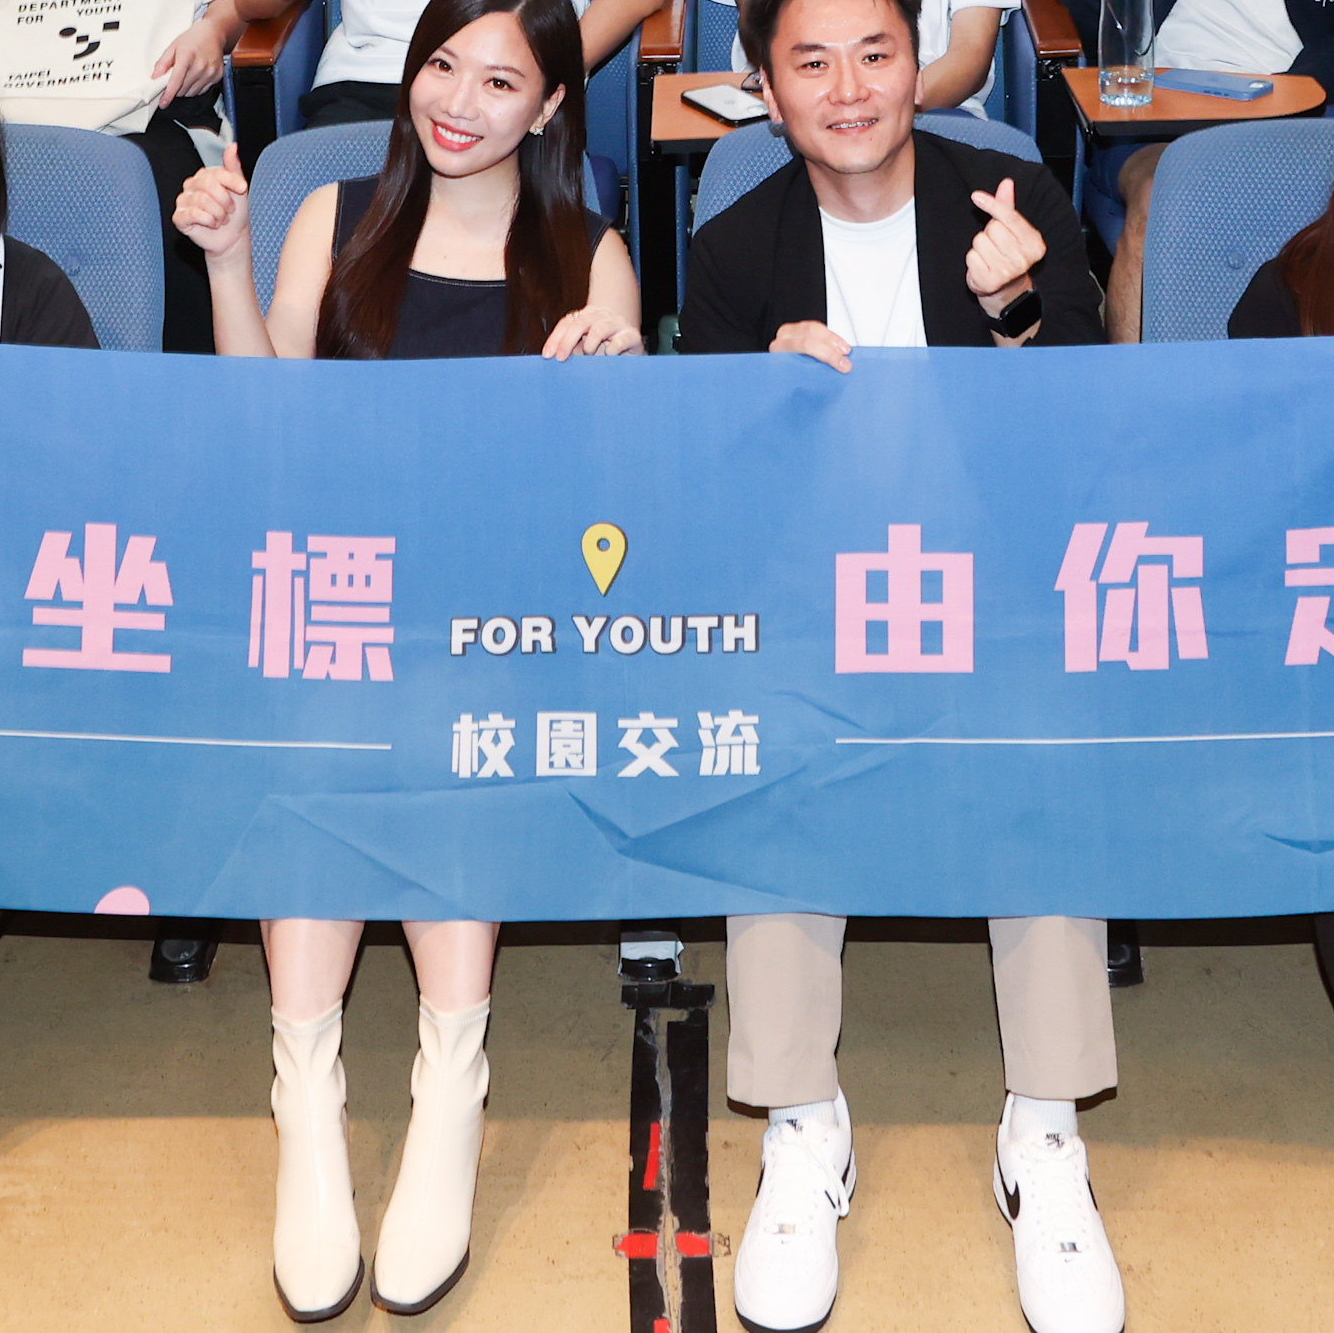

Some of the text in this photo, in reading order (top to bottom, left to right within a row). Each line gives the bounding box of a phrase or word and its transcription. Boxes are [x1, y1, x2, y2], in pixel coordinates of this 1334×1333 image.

[17, 4, 122, 25] FOR YOUTH
[3, 72, 112, 89] GOVERNMENT
[8, 60, 113, 82] TAIPEI CITY
[450, 613, 759, 657] FOR YOUTH
[452, 709, 761, 779] 校園交流
